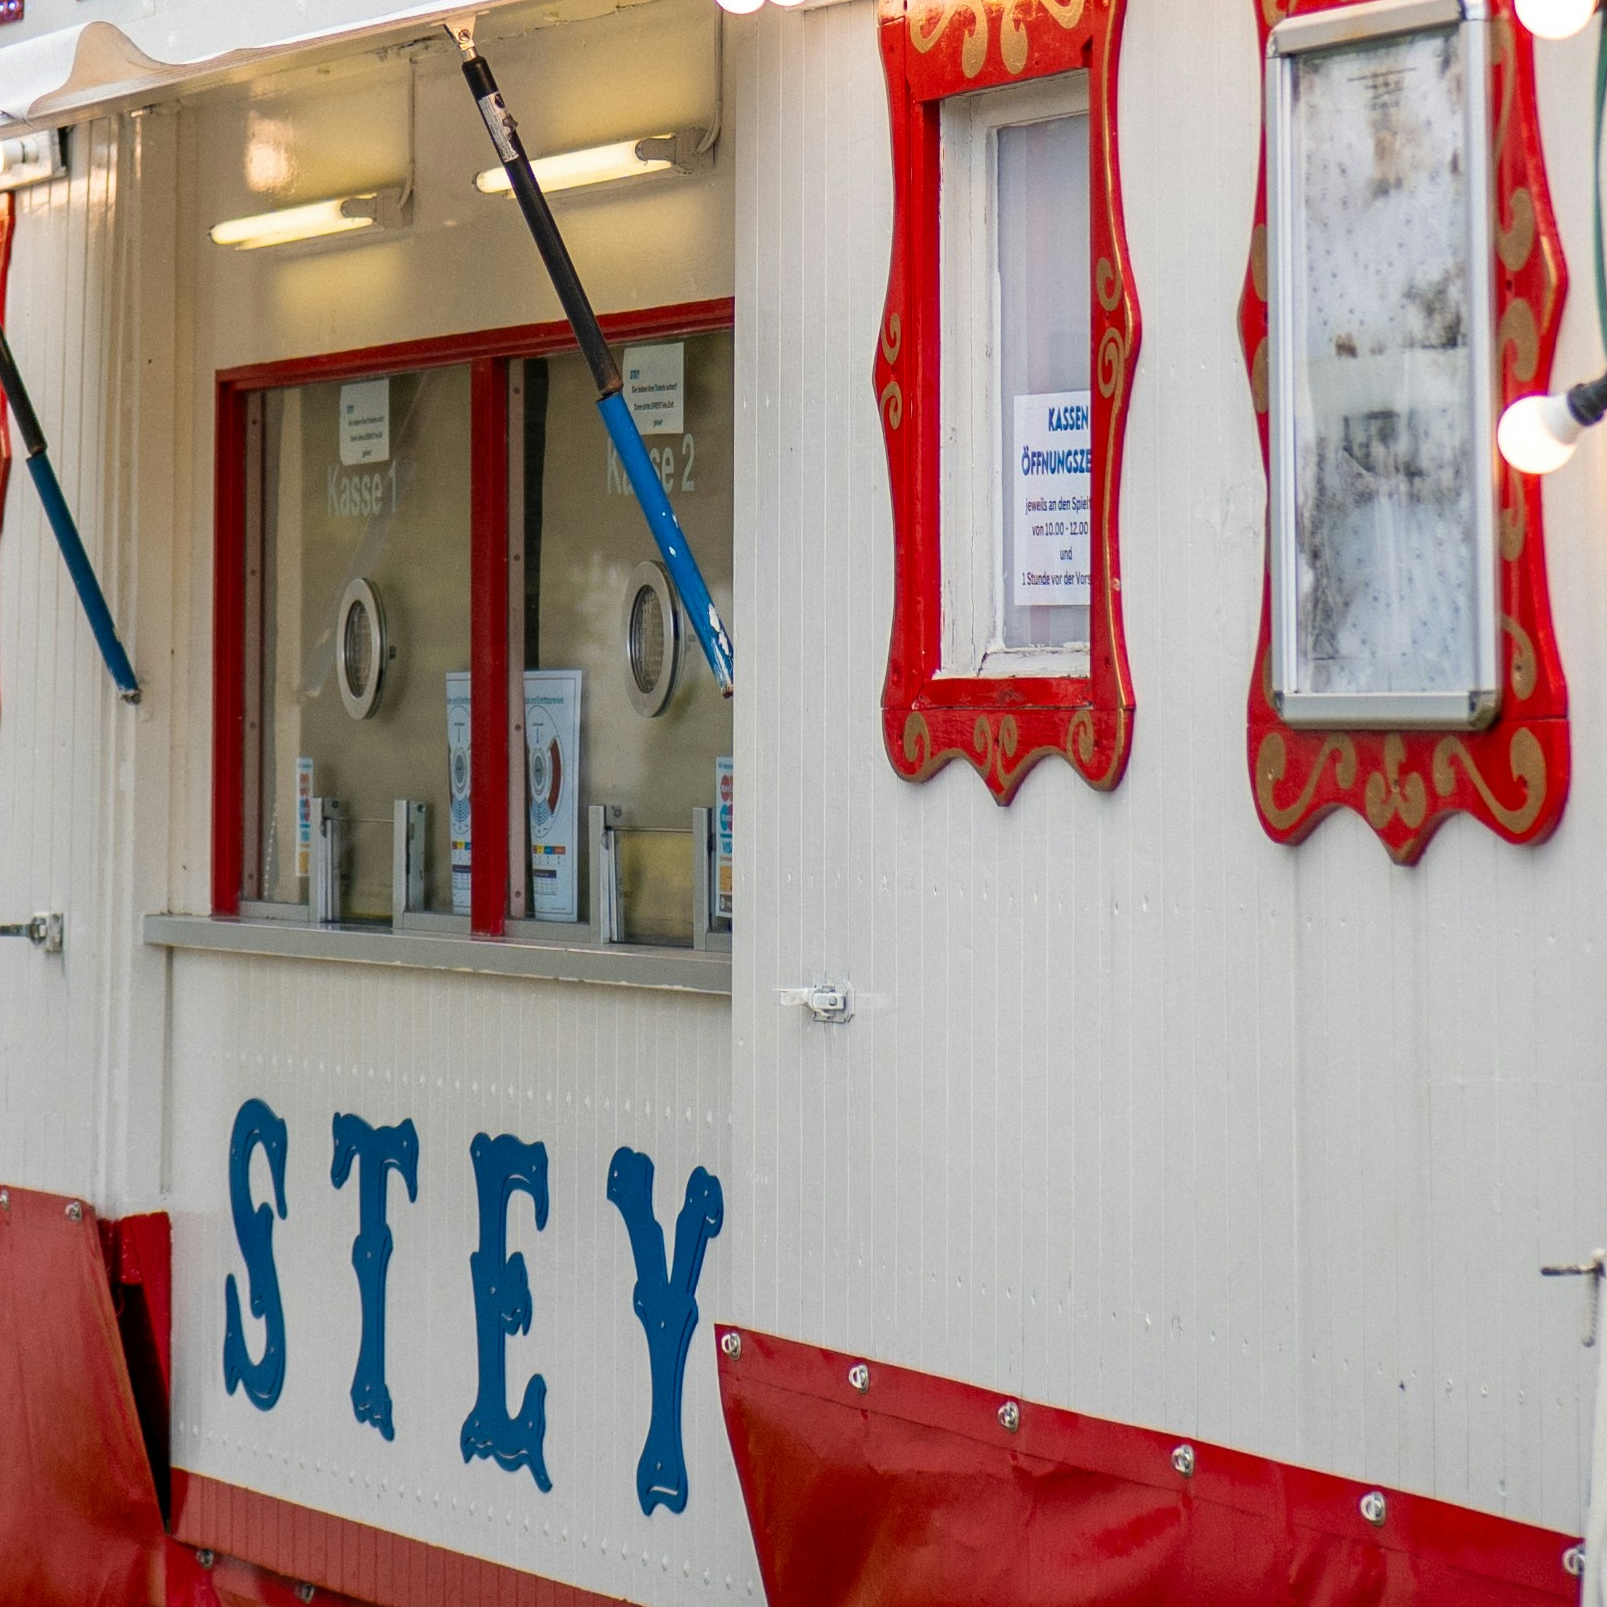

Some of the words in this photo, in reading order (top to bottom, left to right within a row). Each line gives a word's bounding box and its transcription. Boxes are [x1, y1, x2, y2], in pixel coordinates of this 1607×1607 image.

[1048, 405, 1089, 432] KASSEN
[607, 436, 675, 495] Kse
[681, 433, 695, 492] 2
[327, 465, 382, 517] Kasse
[388, 461, 398, 513] 1
[1025, 496, 1048, 515] jeweils
[1048, 500, 1057, 511] an
[1058, 495, 1071, 511] den
[1032, 525, 1044, 536] von
[1045, 521, 1065, 536] 10.00
[1070, 521, 1089, 536] 12.00
[1059, 546, 1073, 561] und
[1026, 570, 1050, 586] Stunde
[1050, 574, 1063, 586] vor
[1063, 570, 1075, 585] der
[223, 1097, 725, 1517] STEY
